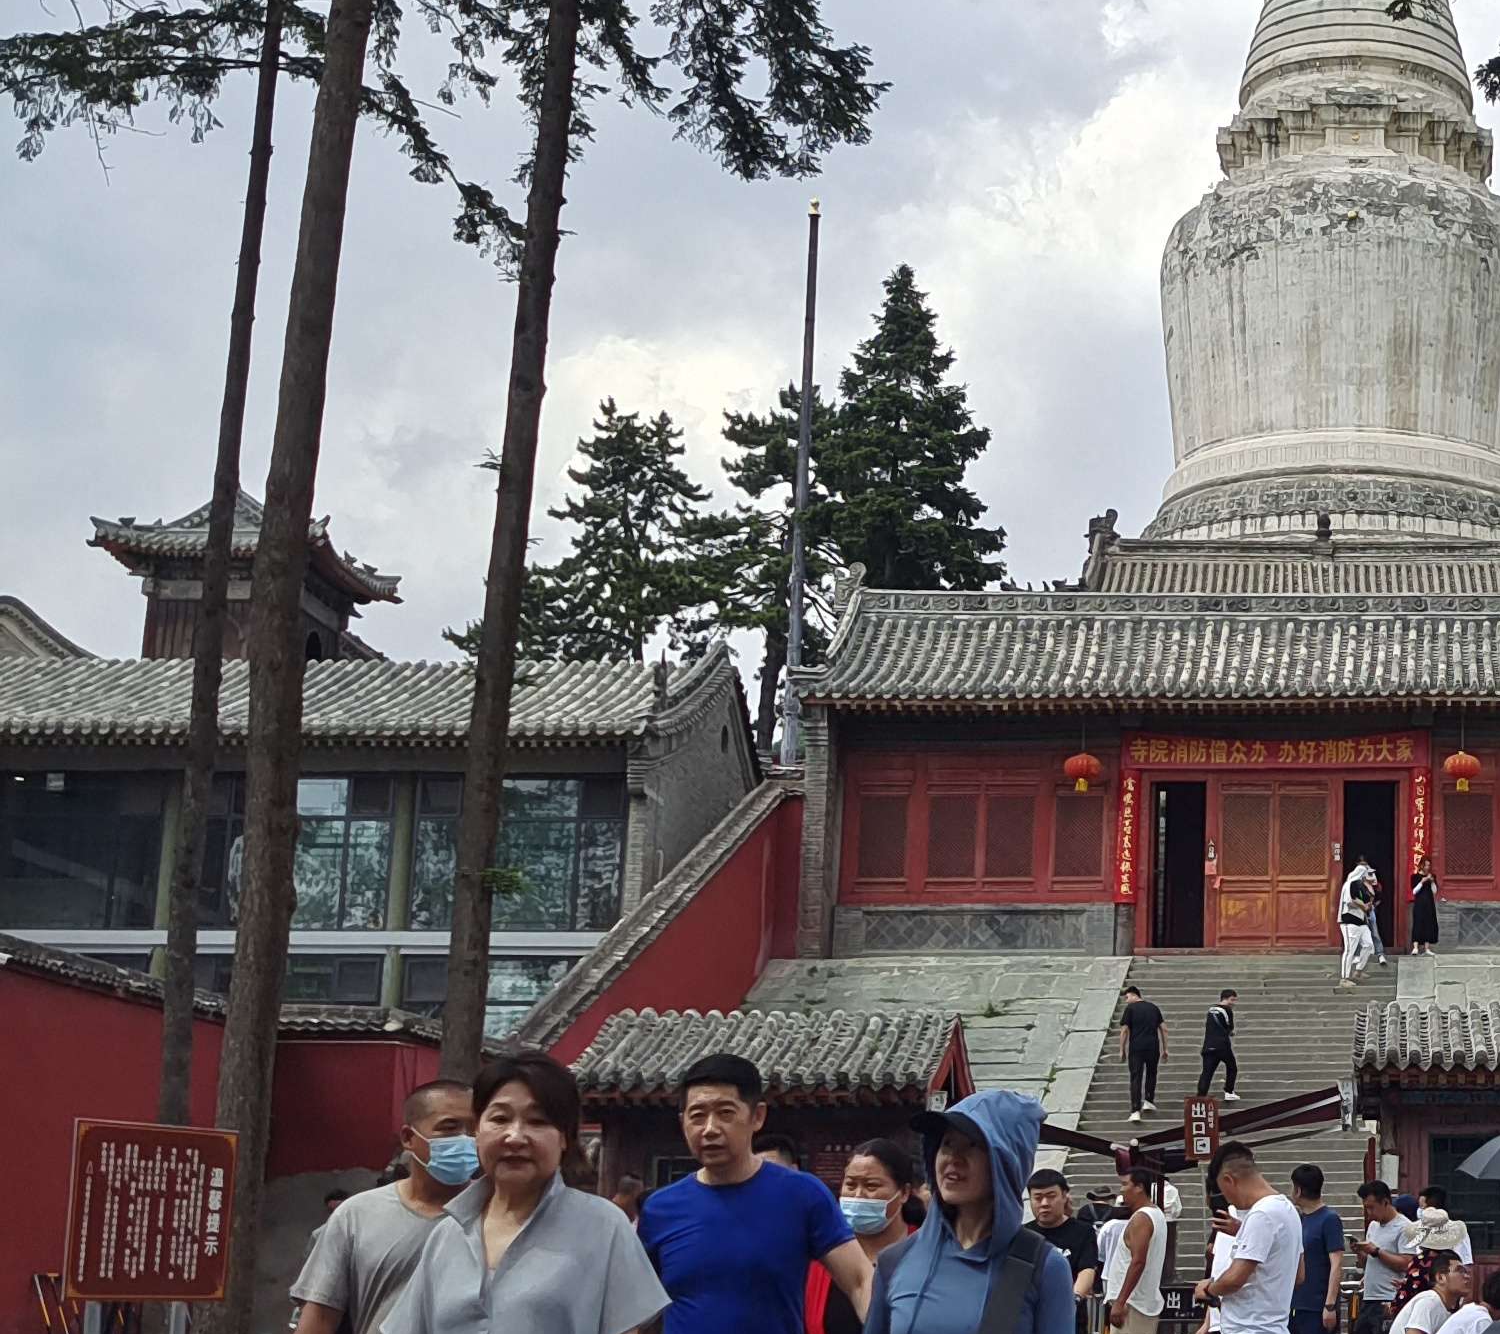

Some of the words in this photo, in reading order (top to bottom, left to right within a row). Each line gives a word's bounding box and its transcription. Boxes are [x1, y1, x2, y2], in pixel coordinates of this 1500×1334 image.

[1130, 738, 1267, 764] 寺院消防僧众办
[1278, 738, 1415, 764] 办好消防为大家
[1191, 1102, 1206, 1135] 出口
